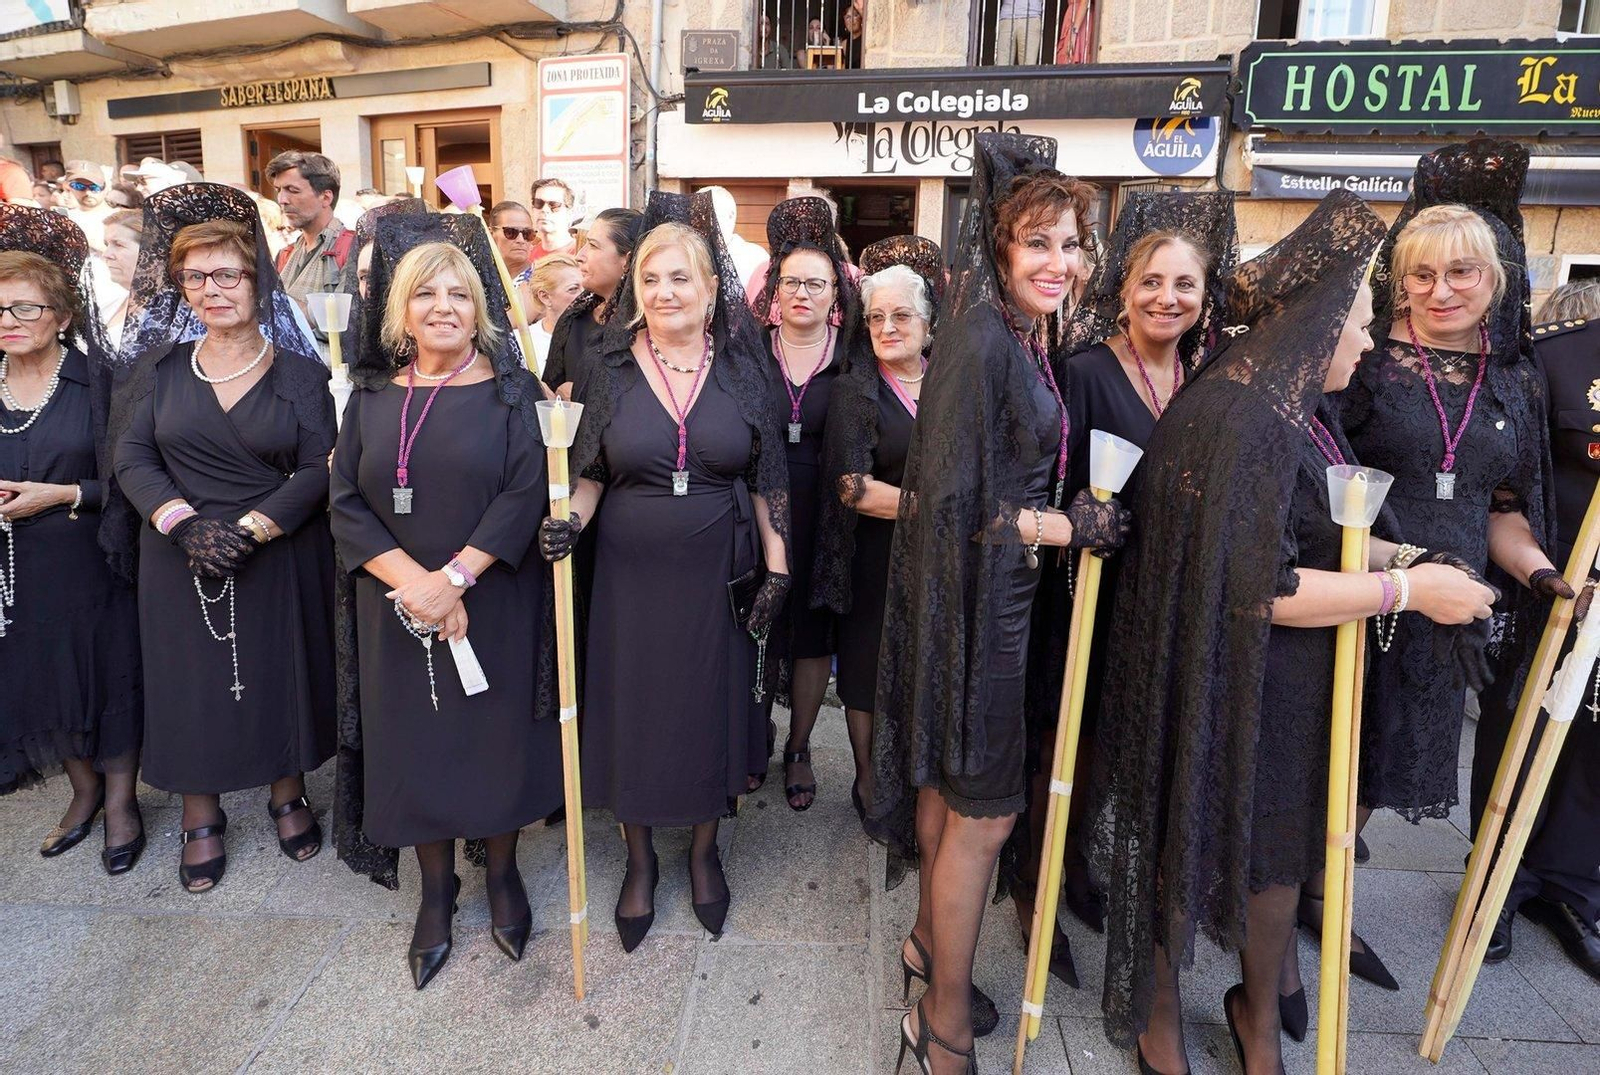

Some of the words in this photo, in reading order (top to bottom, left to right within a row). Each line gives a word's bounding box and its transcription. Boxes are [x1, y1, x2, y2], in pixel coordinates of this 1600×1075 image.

[702, 37, 727, 45] PRAZA
[693, 56, 725, 65] IGREXA
[547, 70, 568, 82] ZONA
[570, 66, 620, 81] PROTEXIDA
[220, 84, 265, 107] SABOR
[276, 77, 331, 103] ESPAÑA
[1282, 63, 1482, 113] HOSTAL
[1516, 56, 1579, 104] La
[857, 92, 890, 113] La
[896, 88, 1029, 118] Colegiala
[862, 121, 898, 173] La
[899, 121, 1019, 172] Coleg
[1173, 135, 1184, 143] EL
[1142, 141, 1203, 158] ÁGUILA
[1279, 175, 1341, 190] Estrella
[1344, 175, 1403, 193] Galicia
